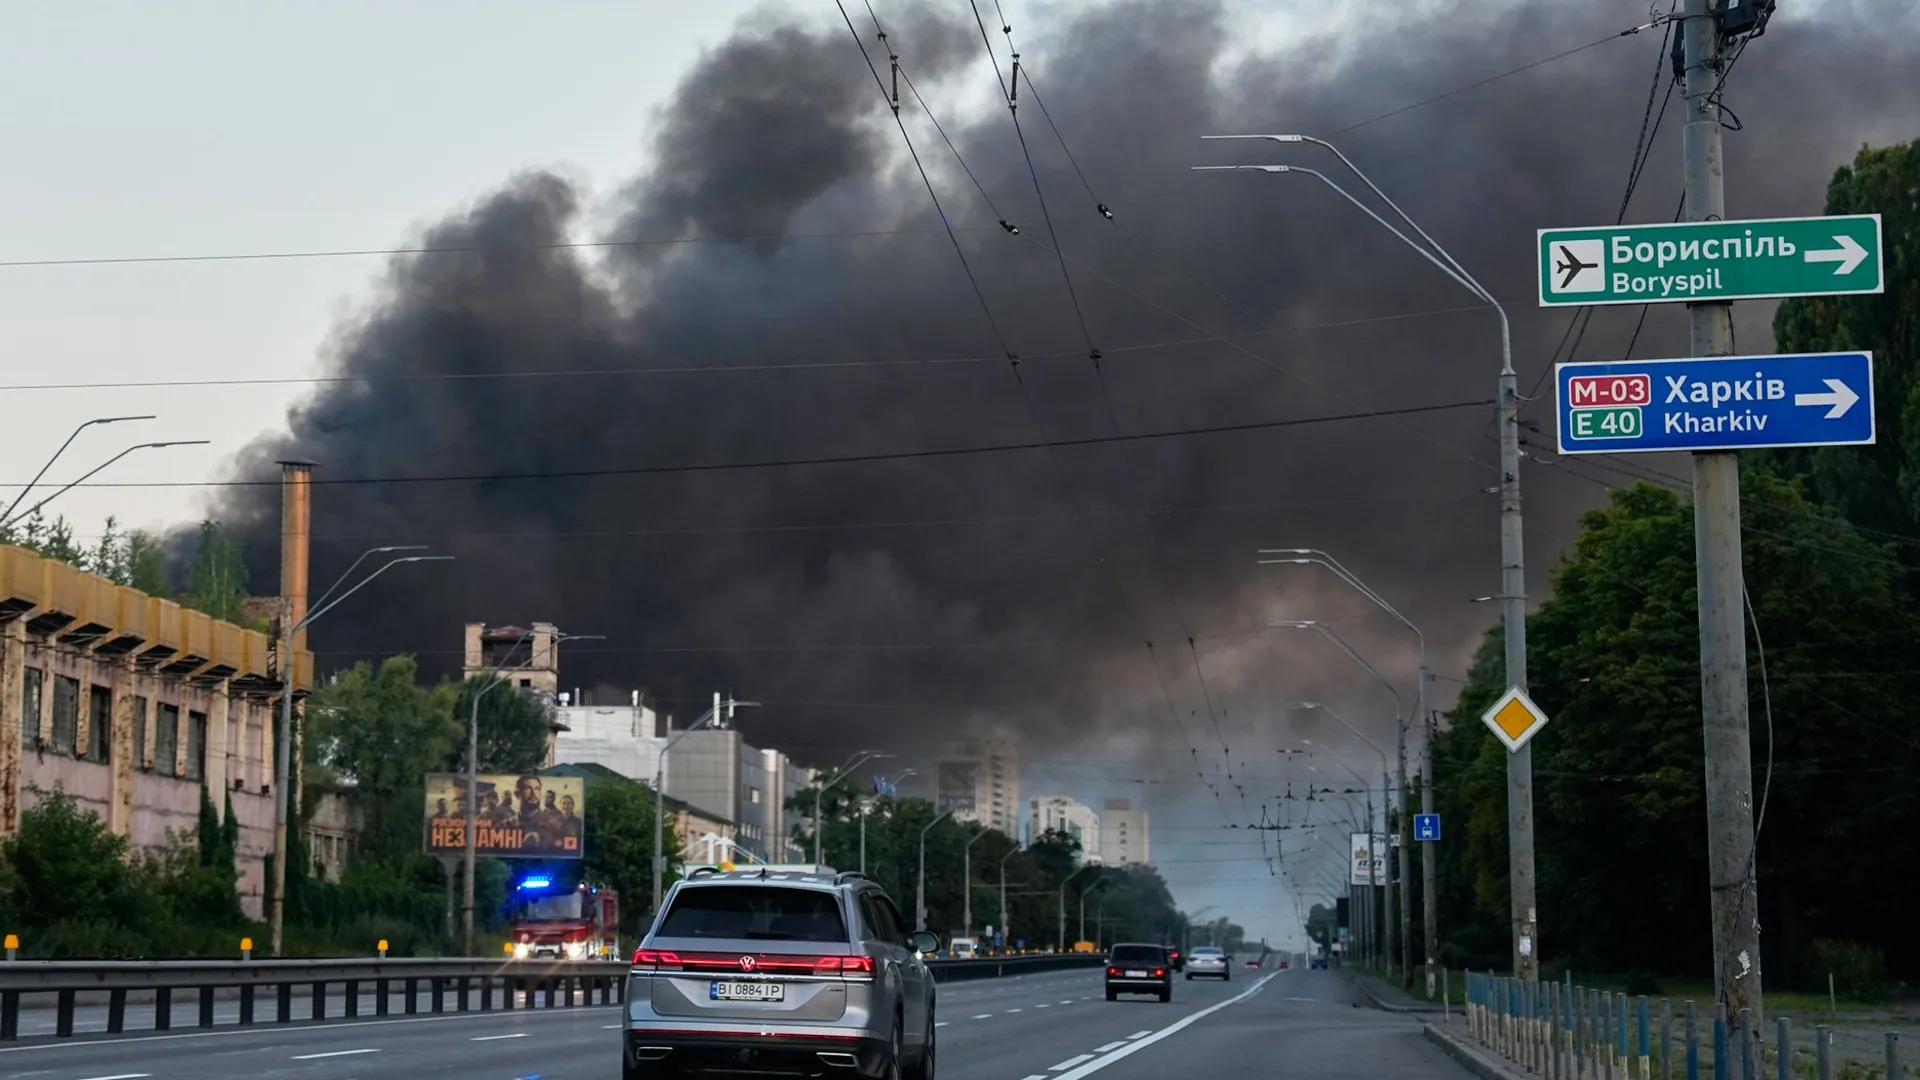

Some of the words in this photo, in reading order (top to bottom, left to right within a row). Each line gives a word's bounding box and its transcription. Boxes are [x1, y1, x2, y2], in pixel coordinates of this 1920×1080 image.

[1611, 229, 1797, 268] Бориспіль
[1612, 268, 1722, 296] Boryspil
[1573, 378, 1645, 403] M-03
[1664, 371, 1785, 408] Харків
[1576, 413, 1593, 435] E
[1600, 411, 1636, 434] 40
[1664, 409, 1768, 434] Kharkiv
[718, 983, 732, 995] BI
[735, 984, 762, 996] 0884
